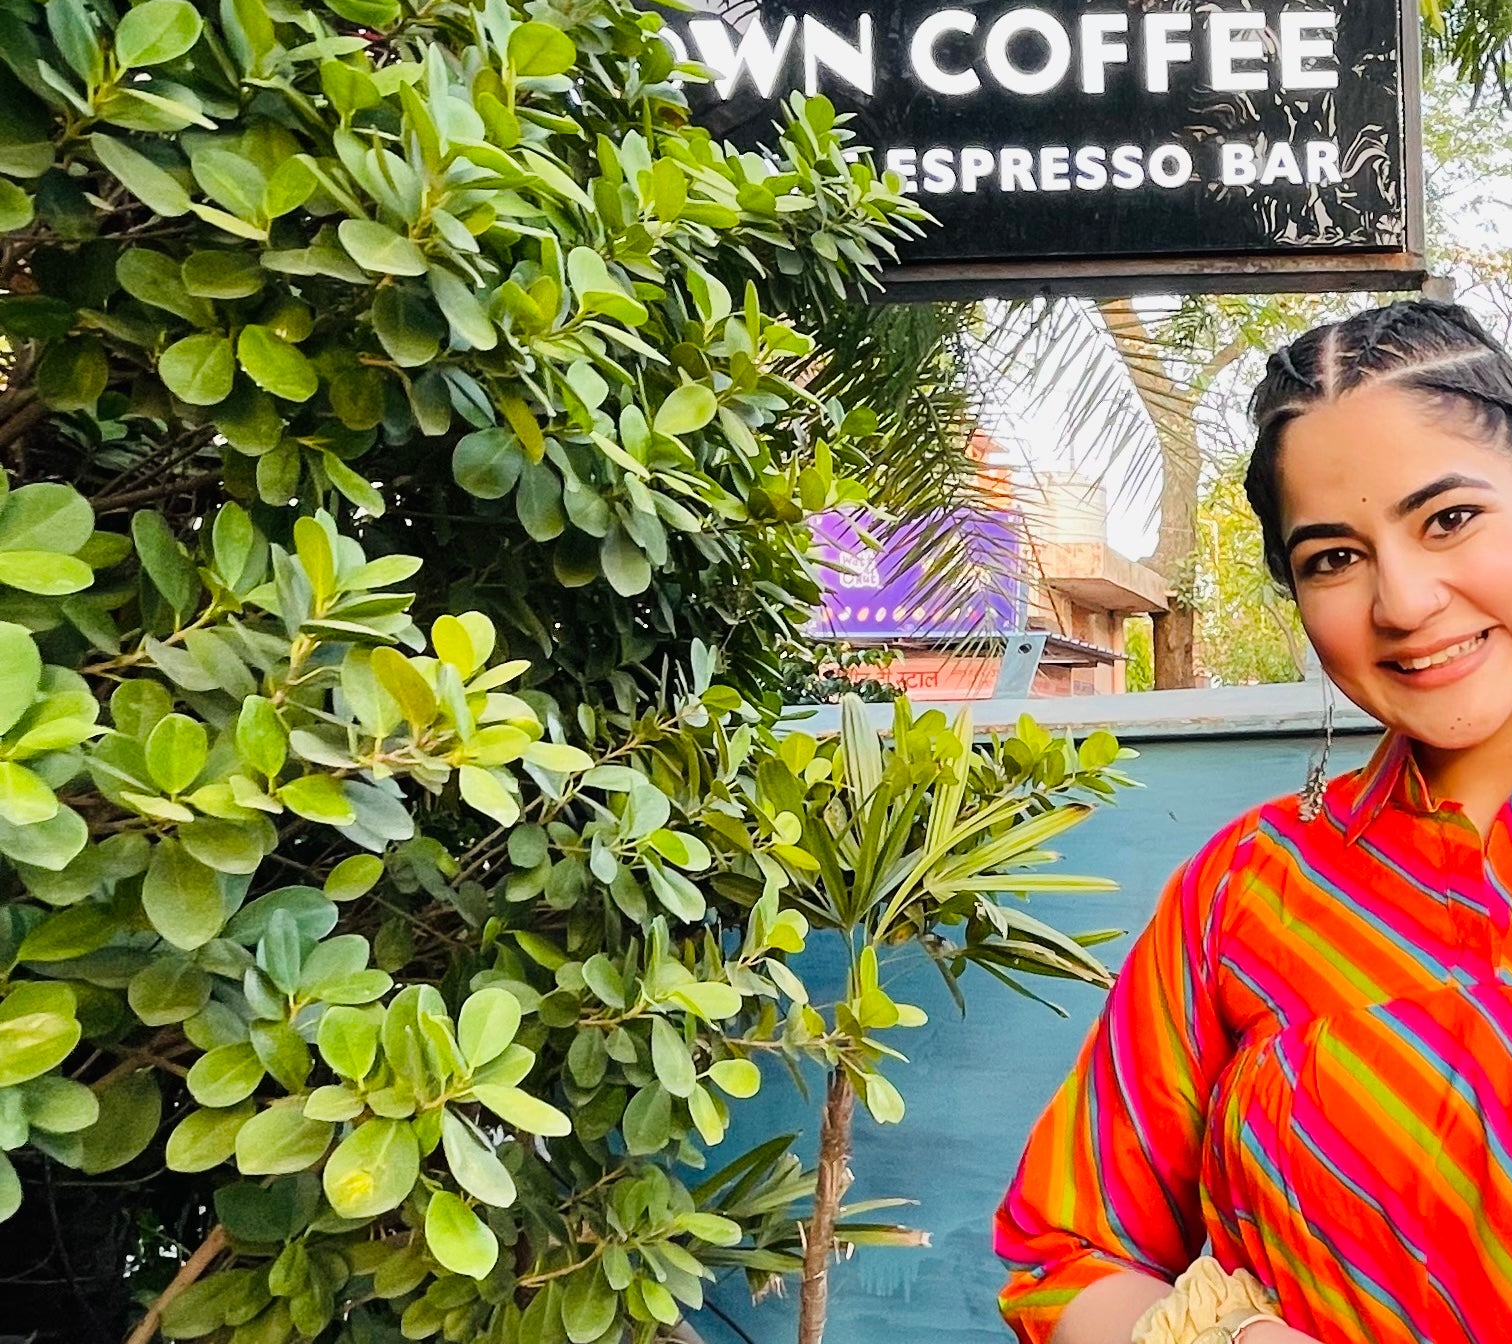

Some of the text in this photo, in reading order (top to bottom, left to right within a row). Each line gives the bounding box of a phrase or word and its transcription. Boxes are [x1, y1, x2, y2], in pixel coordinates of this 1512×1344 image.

[910, 8, 1340, 96] COFFEE
[886, 144, 1194, 193] ESPRESSO
[1221, 140, 1344, 187] BAR
